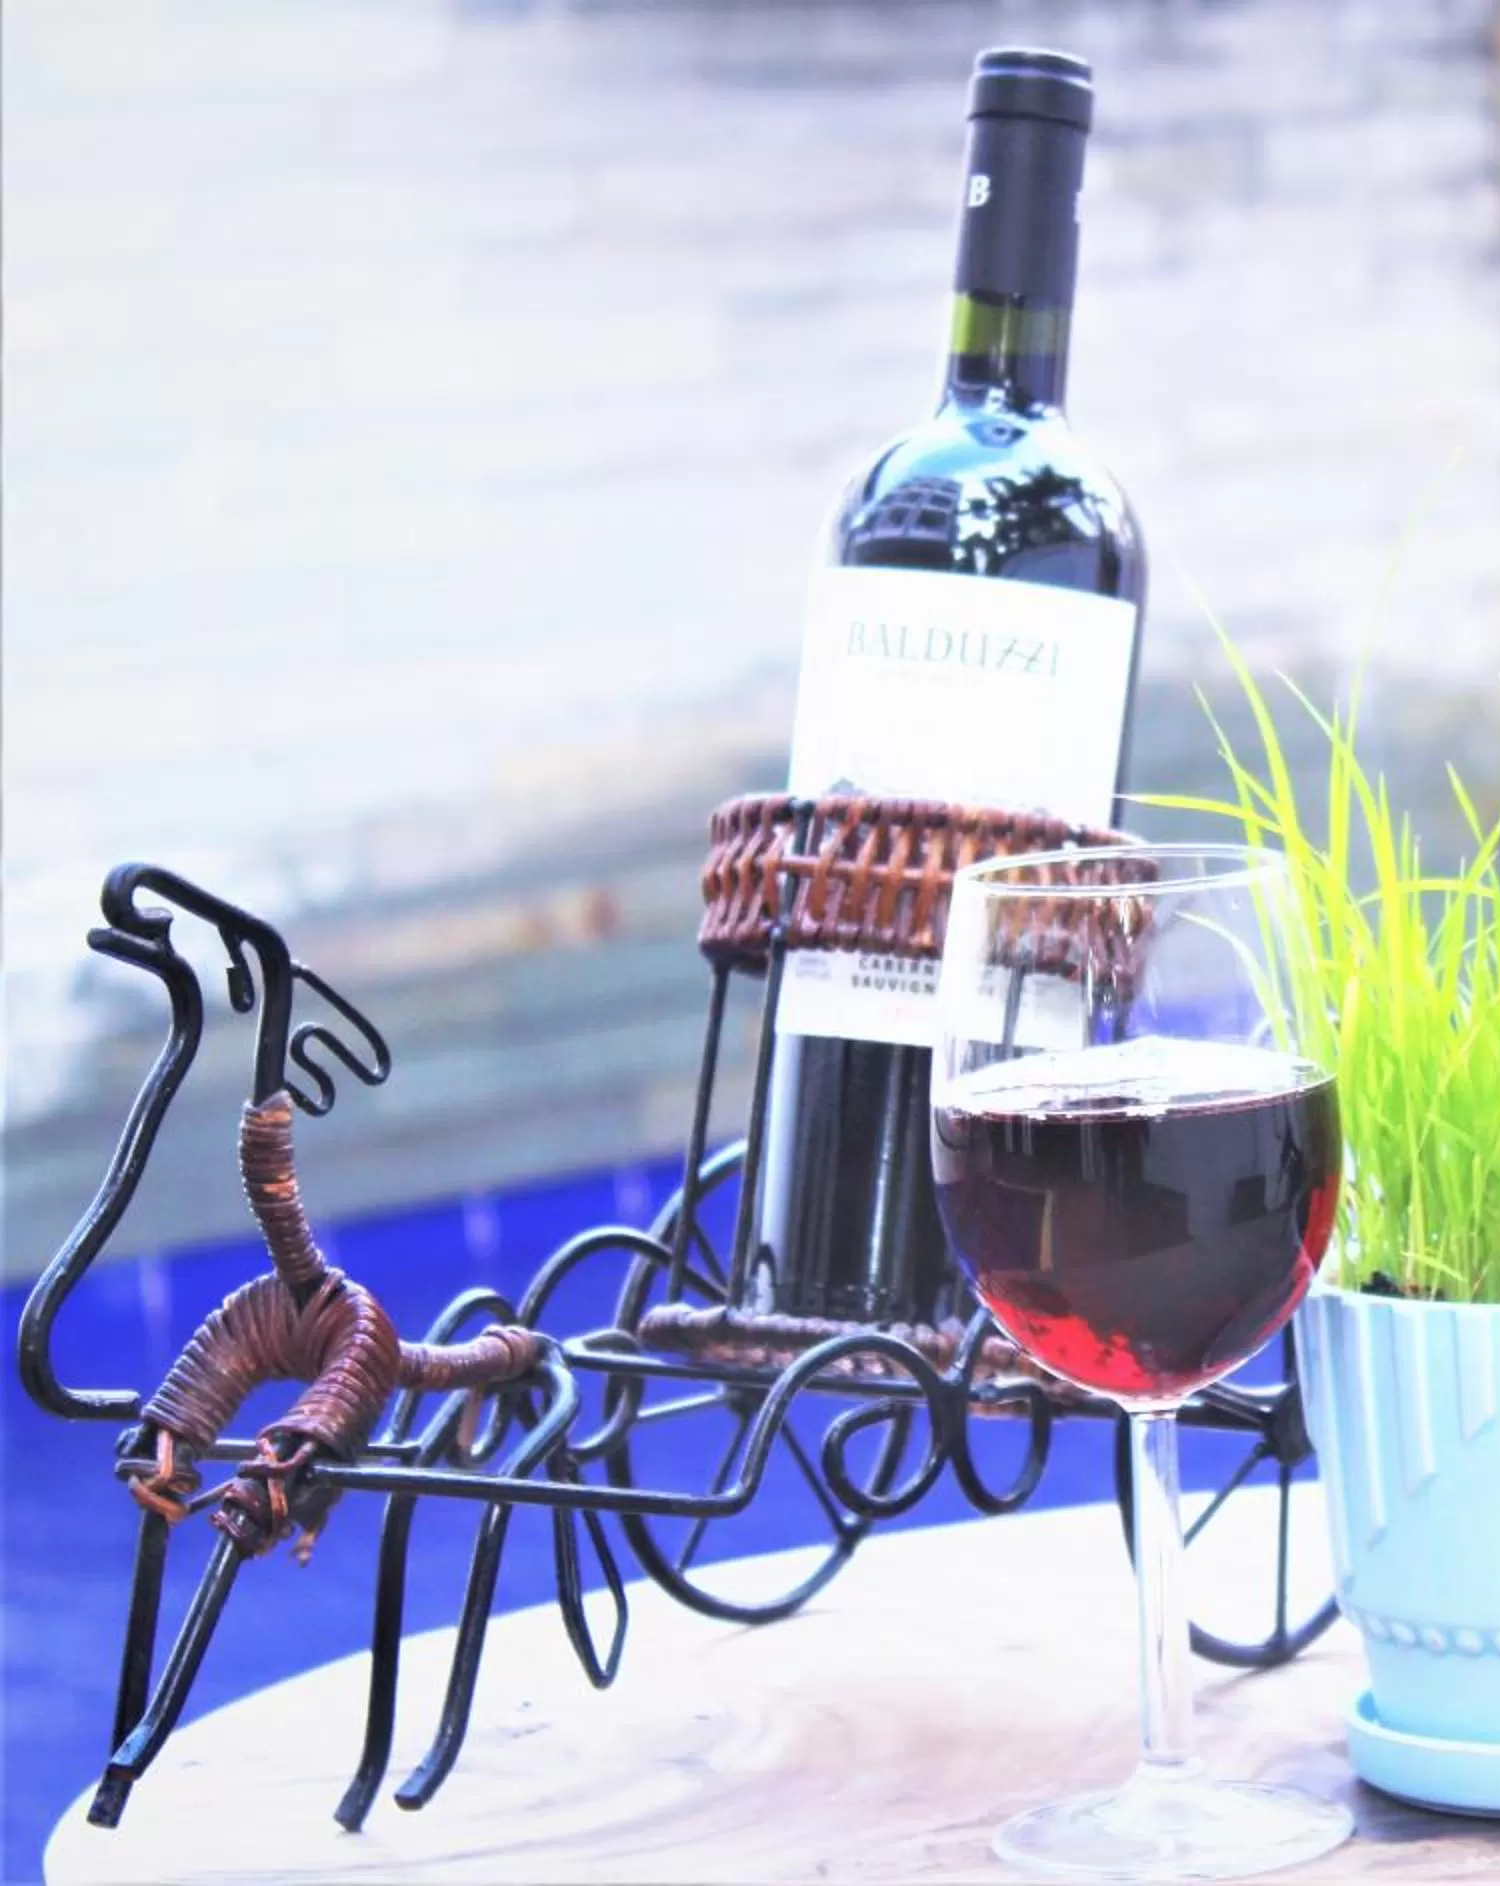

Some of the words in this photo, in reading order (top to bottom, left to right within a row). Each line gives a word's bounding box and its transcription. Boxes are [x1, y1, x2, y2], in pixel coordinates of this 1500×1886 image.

[968, 173, 992, 208] B
[845, 619, 1061, 679] BALDUZZI
[858, 957, 936, 977] CABERN
[850, 973, 937, 996] SAUVIGN
